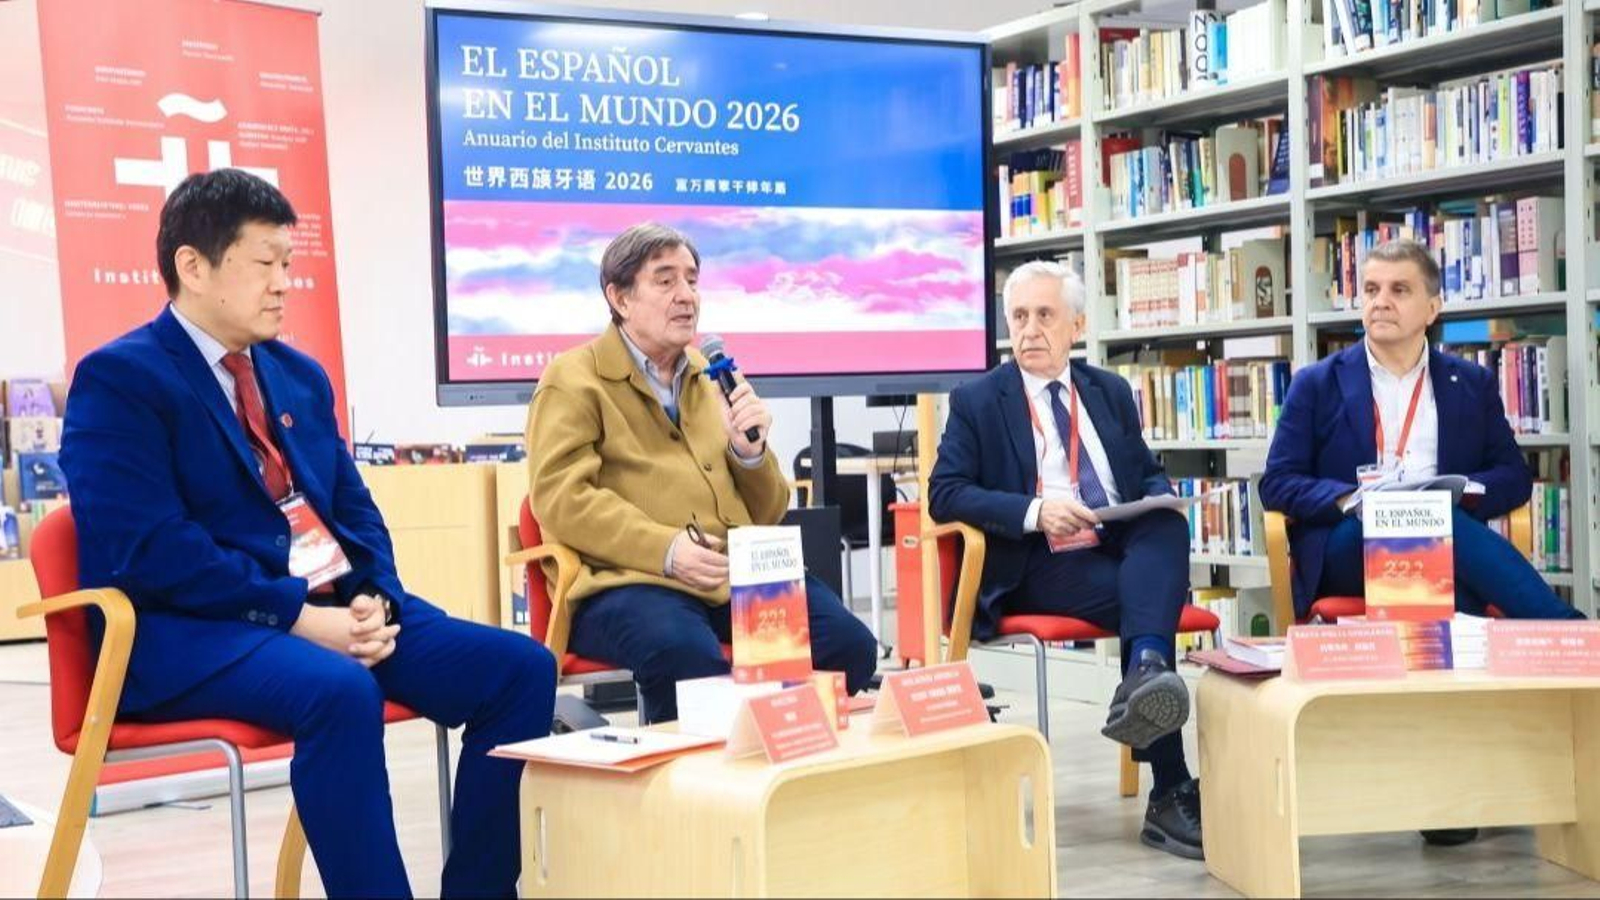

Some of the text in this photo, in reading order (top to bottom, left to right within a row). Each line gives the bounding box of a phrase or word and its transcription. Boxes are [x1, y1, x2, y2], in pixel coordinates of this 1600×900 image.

[461, 45, 680, 87] EL ESPAÑOL
[462, 88, 801, 132] EN EL MUNDO 2026
[463, 129, 739, 155] Anuario del Instituto Cervantes
[605, 172, 653, 190] 2026
[94, 267, 161, 286] Instit
